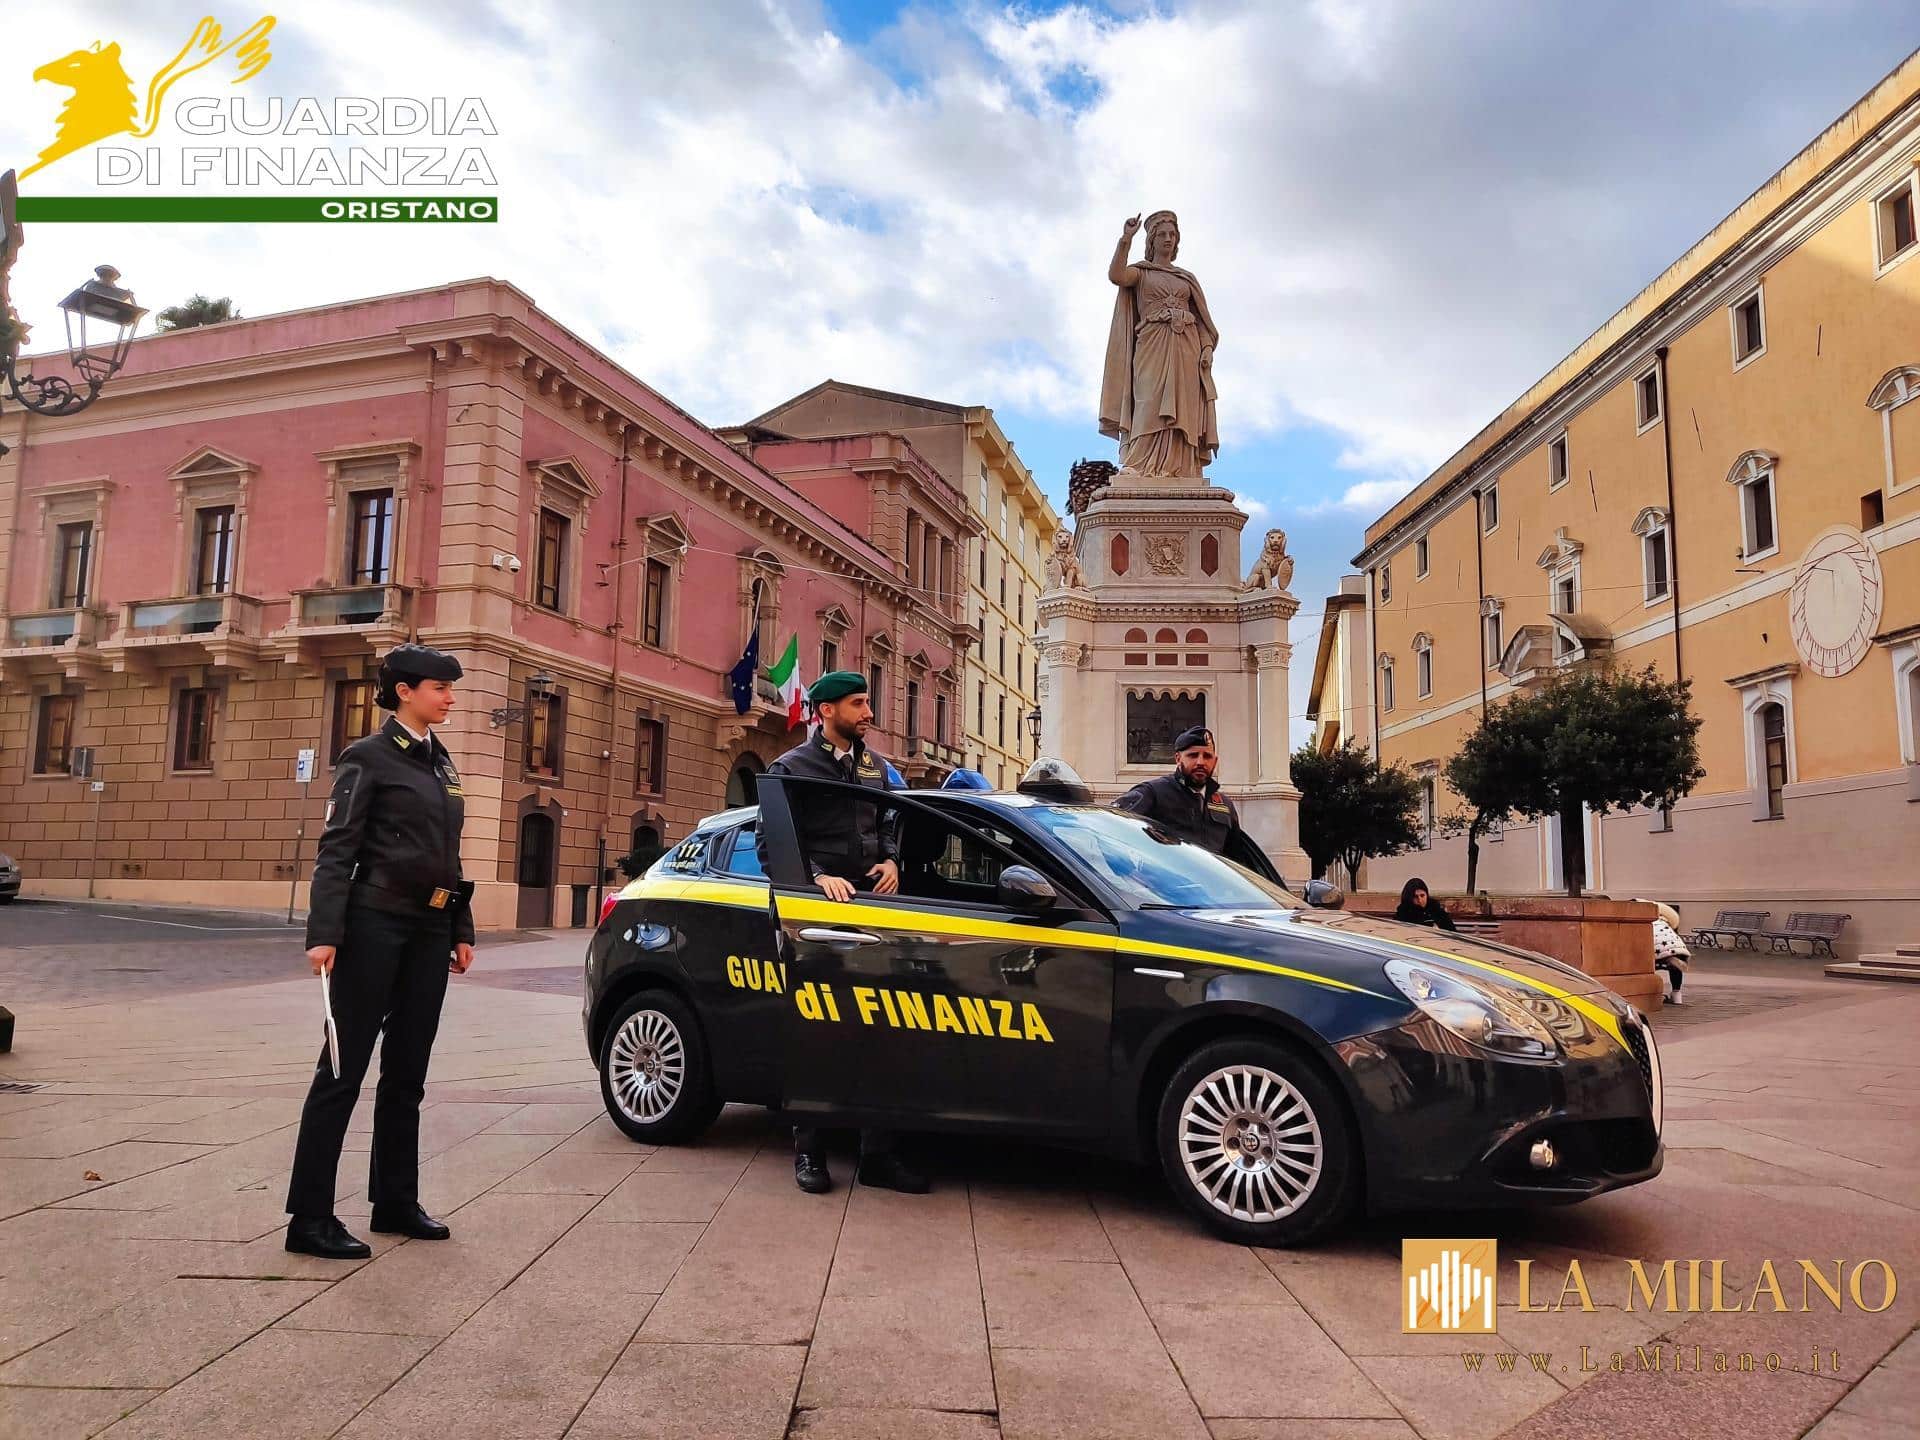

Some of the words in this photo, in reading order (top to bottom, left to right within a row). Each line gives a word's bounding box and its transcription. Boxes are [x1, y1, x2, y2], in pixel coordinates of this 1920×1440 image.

[679, 843, 704, 858] 117
[795, 981, 841, 1022] di
[852, 986, 1055, 1043] FINANZA
